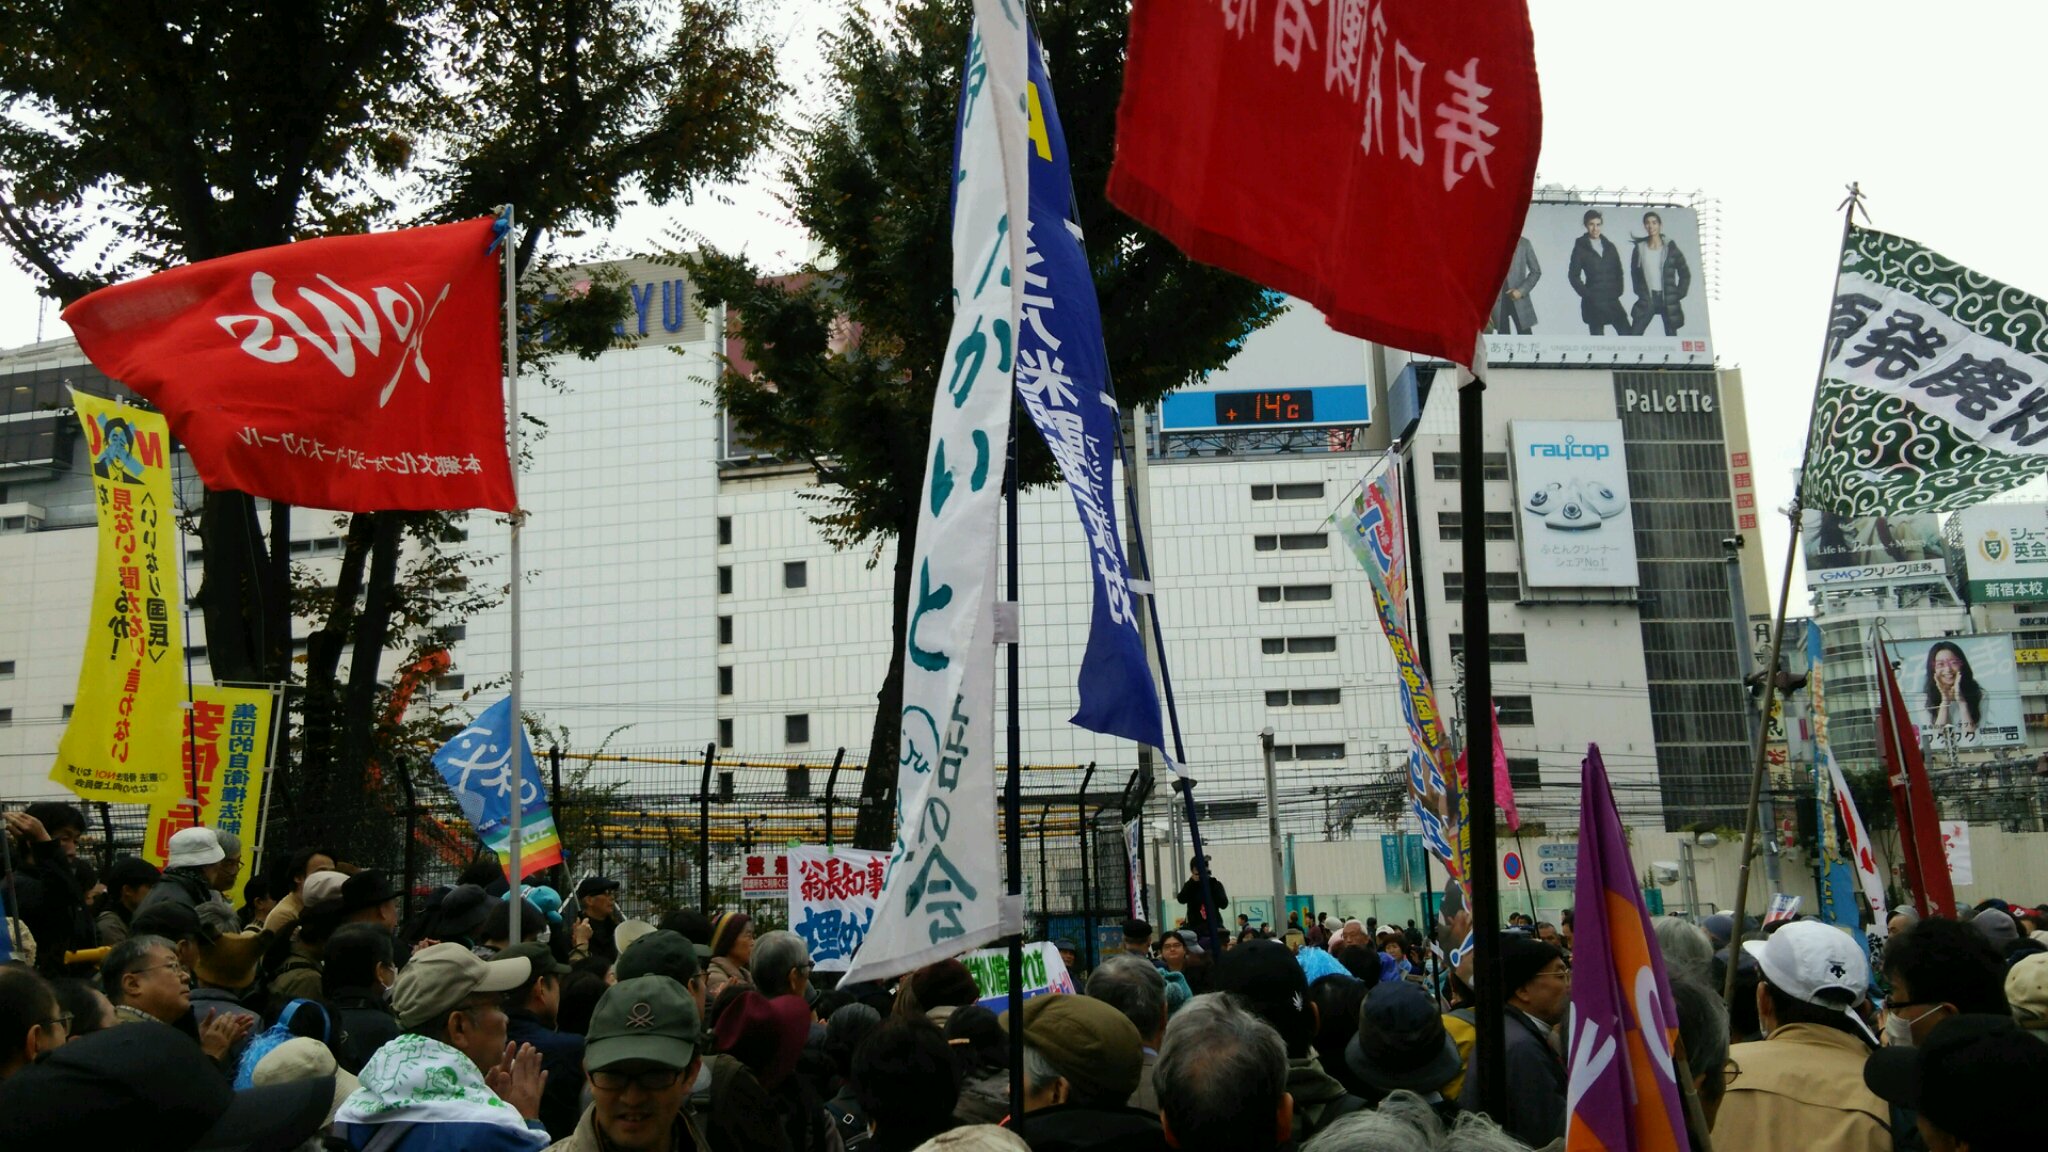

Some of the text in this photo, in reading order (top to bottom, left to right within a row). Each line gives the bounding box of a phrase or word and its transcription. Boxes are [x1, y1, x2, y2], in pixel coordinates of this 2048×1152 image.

[1530, 437, 1609, 460] raycop
[1984, 581, 2044, 597] 新宿本校
[799, 855, 891, 902] 翁長知事
